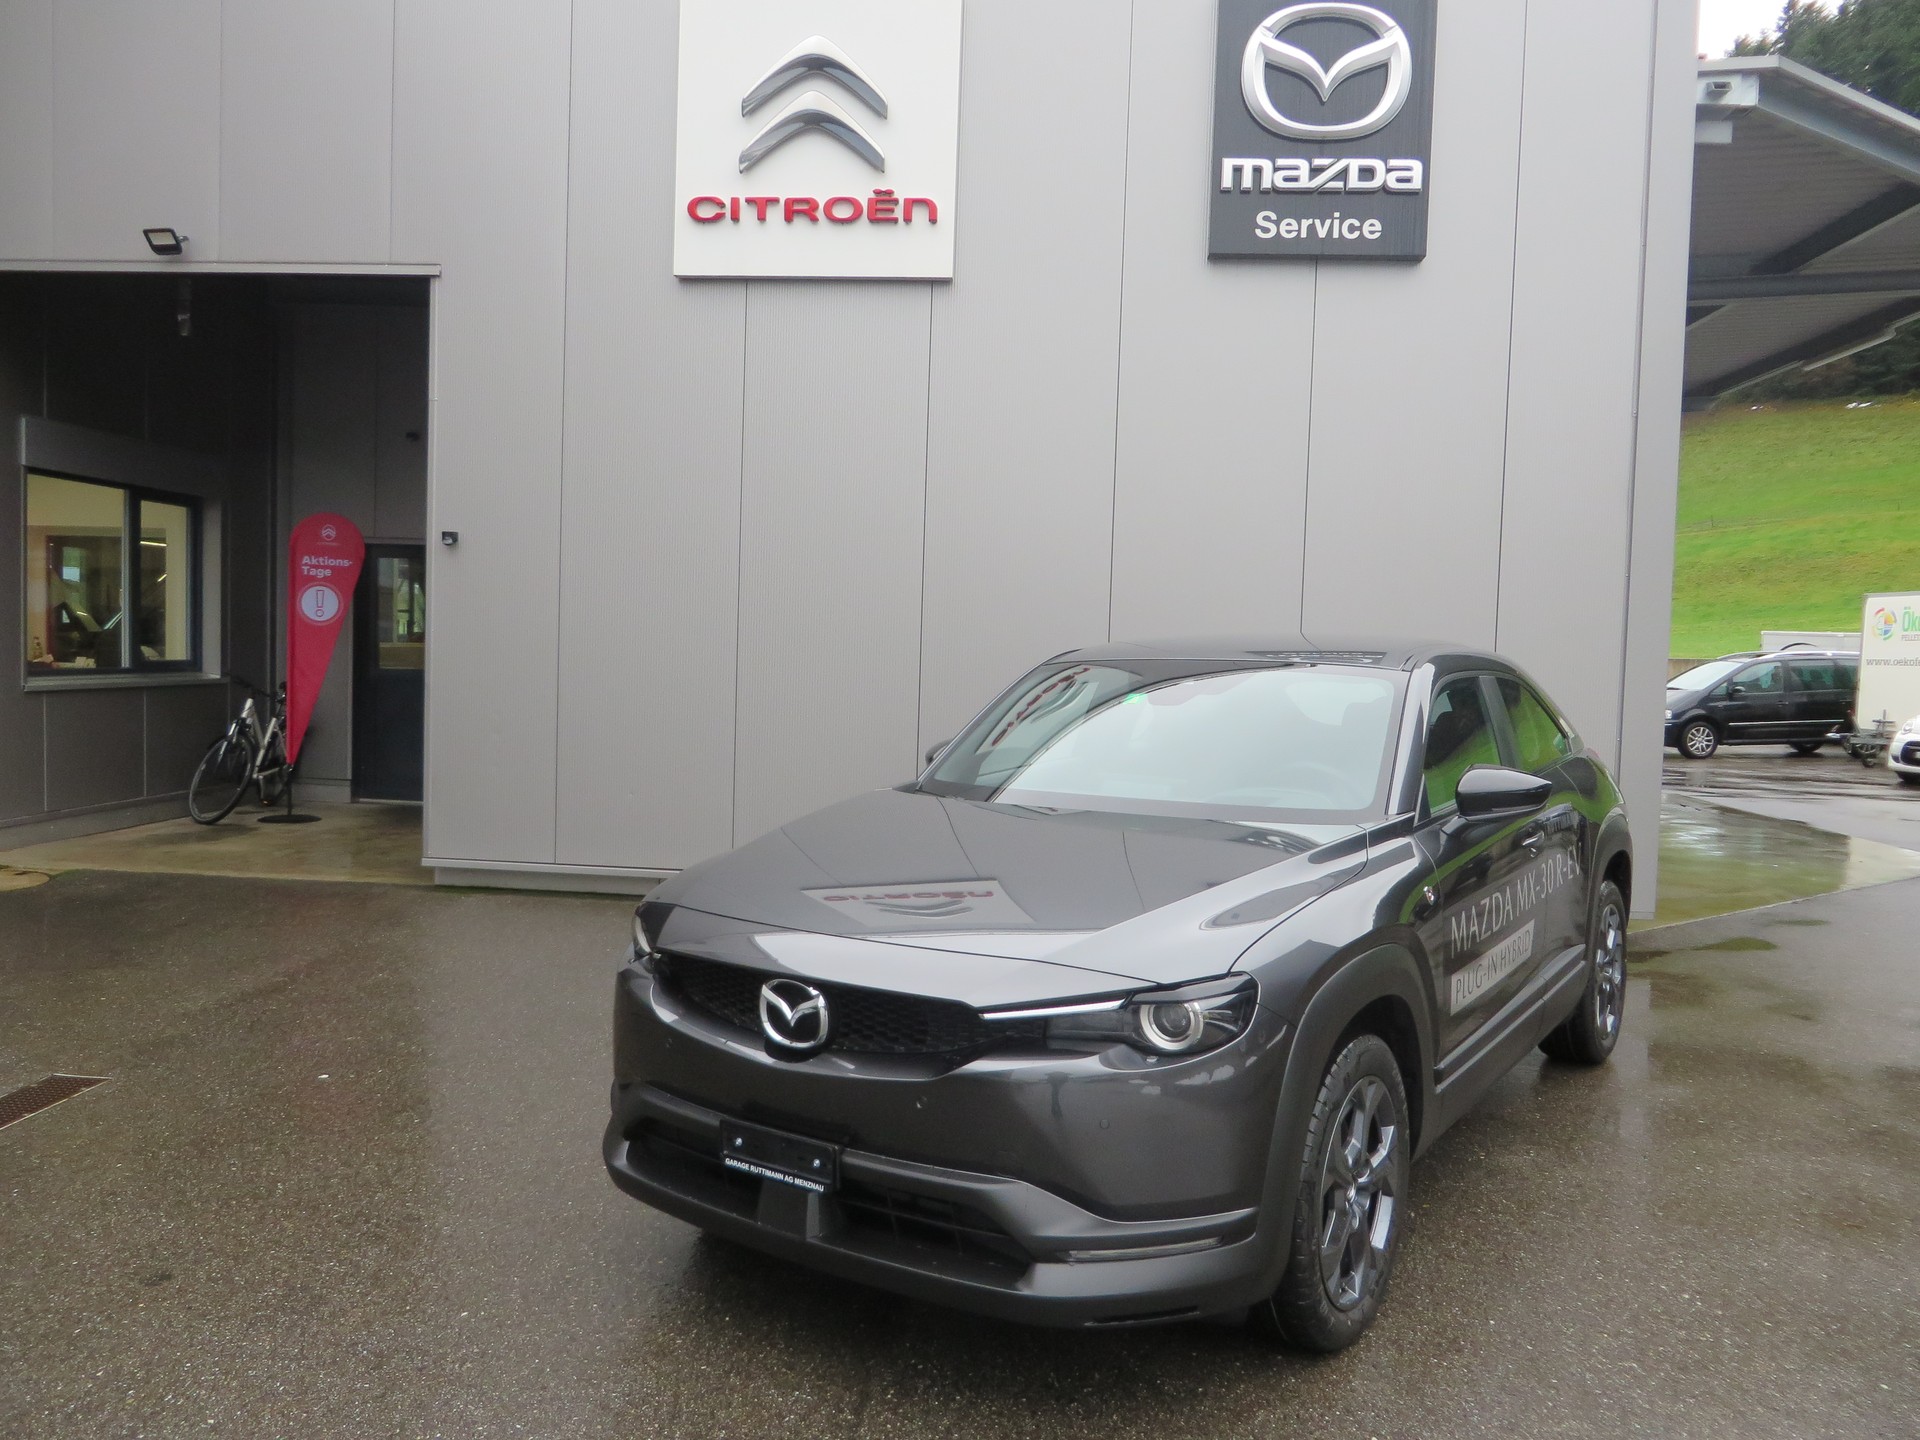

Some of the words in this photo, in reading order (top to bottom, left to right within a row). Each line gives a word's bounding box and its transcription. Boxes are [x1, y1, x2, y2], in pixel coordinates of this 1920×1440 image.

[1254, 210, 1383, 240] Service
[302, 555, 353, 567] Aktions-
[302, 566, 332, 578] Tage
[1451, 886, 1513, 959] MAZDA
[1516, 859, 1553, 917] MX-30
[1455, 955, 1498, 1004] PLUG-IN
[1500, 930, 1531, 972] HYBRID
[725, 1157, 749, 1171] GARAGE
[784, 1175, 794, 1183] AG
[794, 1177, 825, 1192] MENZNAU
